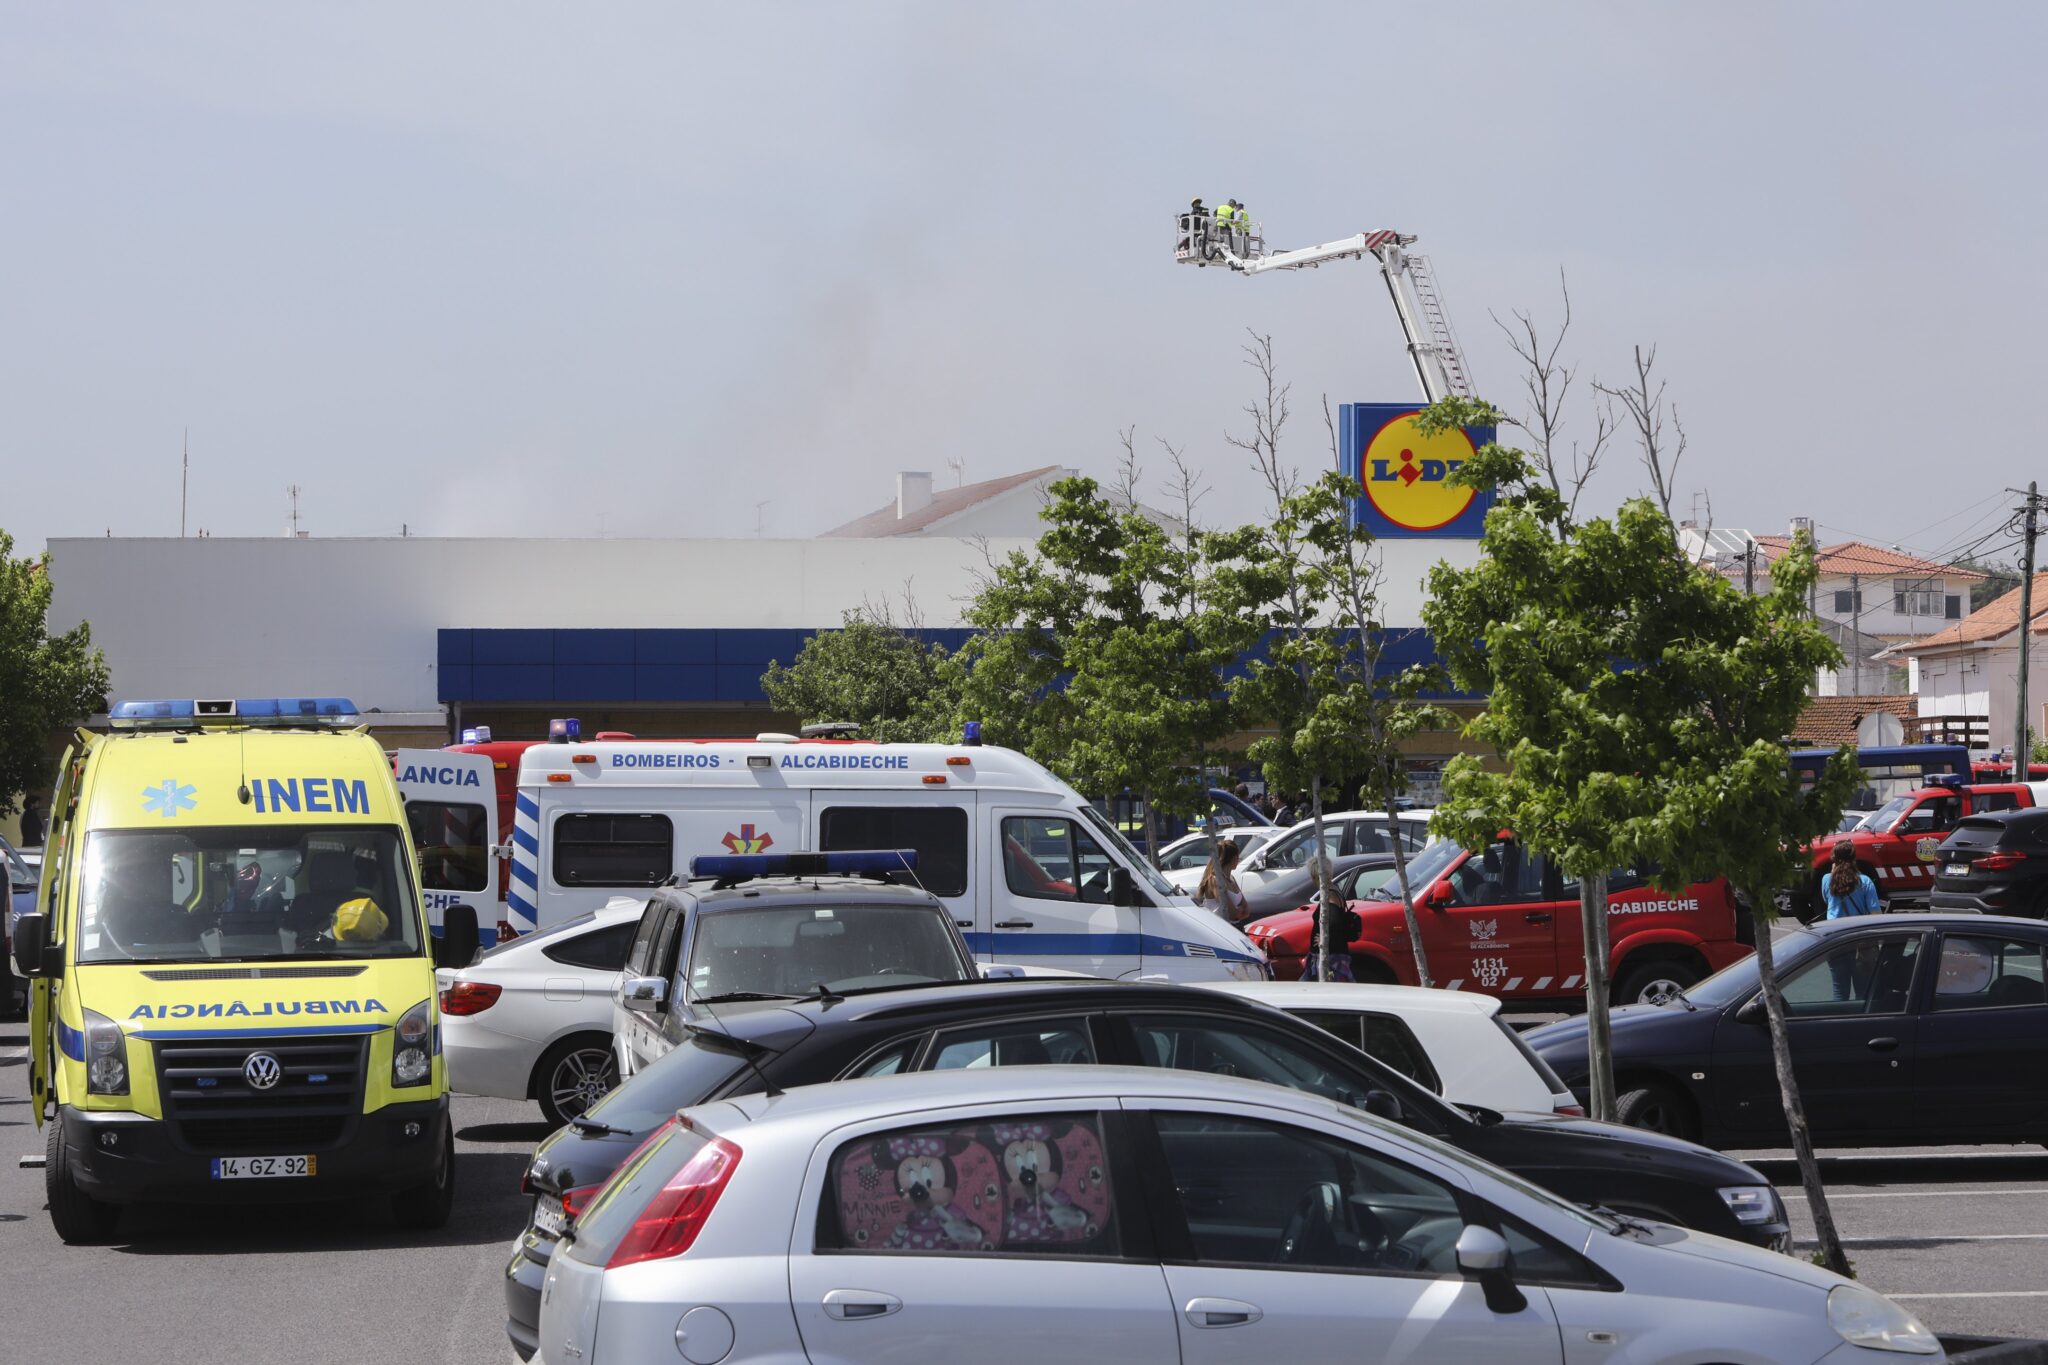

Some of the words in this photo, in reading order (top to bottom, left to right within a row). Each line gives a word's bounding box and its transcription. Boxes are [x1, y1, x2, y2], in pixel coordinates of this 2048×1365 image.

[612, 754, 720, 768] BOMBEIROS
[780, 755, 909, 769] ALCABIDECHE
[396, 765, 480, 787] ANCIA
[251, 778, 371, 815] INEM
[1472, 957, 1504, 968] 1131
[1472, 966, 1509, 977] VCOT
[1481, 976, 1498, 987] 02
